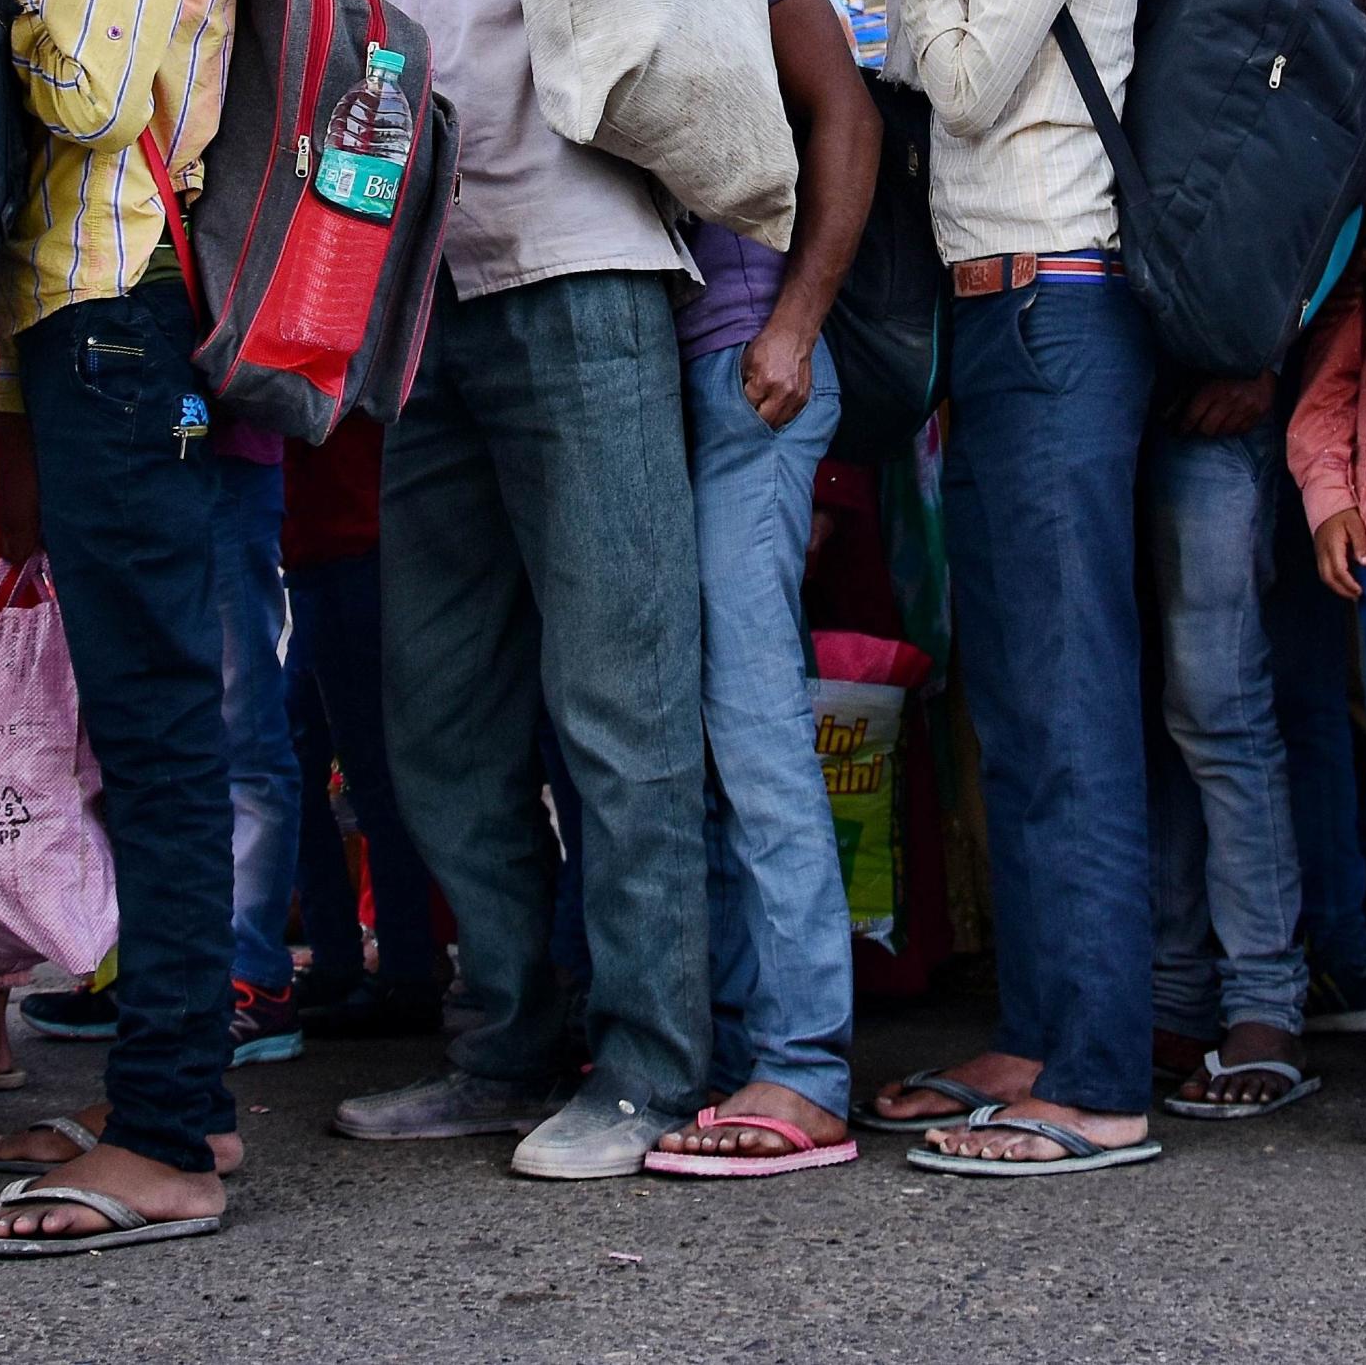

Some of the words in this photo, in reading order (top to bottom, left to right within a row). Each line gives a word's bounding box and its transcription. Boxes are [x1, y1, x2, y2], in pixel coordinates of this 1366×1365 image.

[363, 174, 399, 201] Bisl
[815, 714, 868, 756] ini
[4, 802, 14, 817] 5
